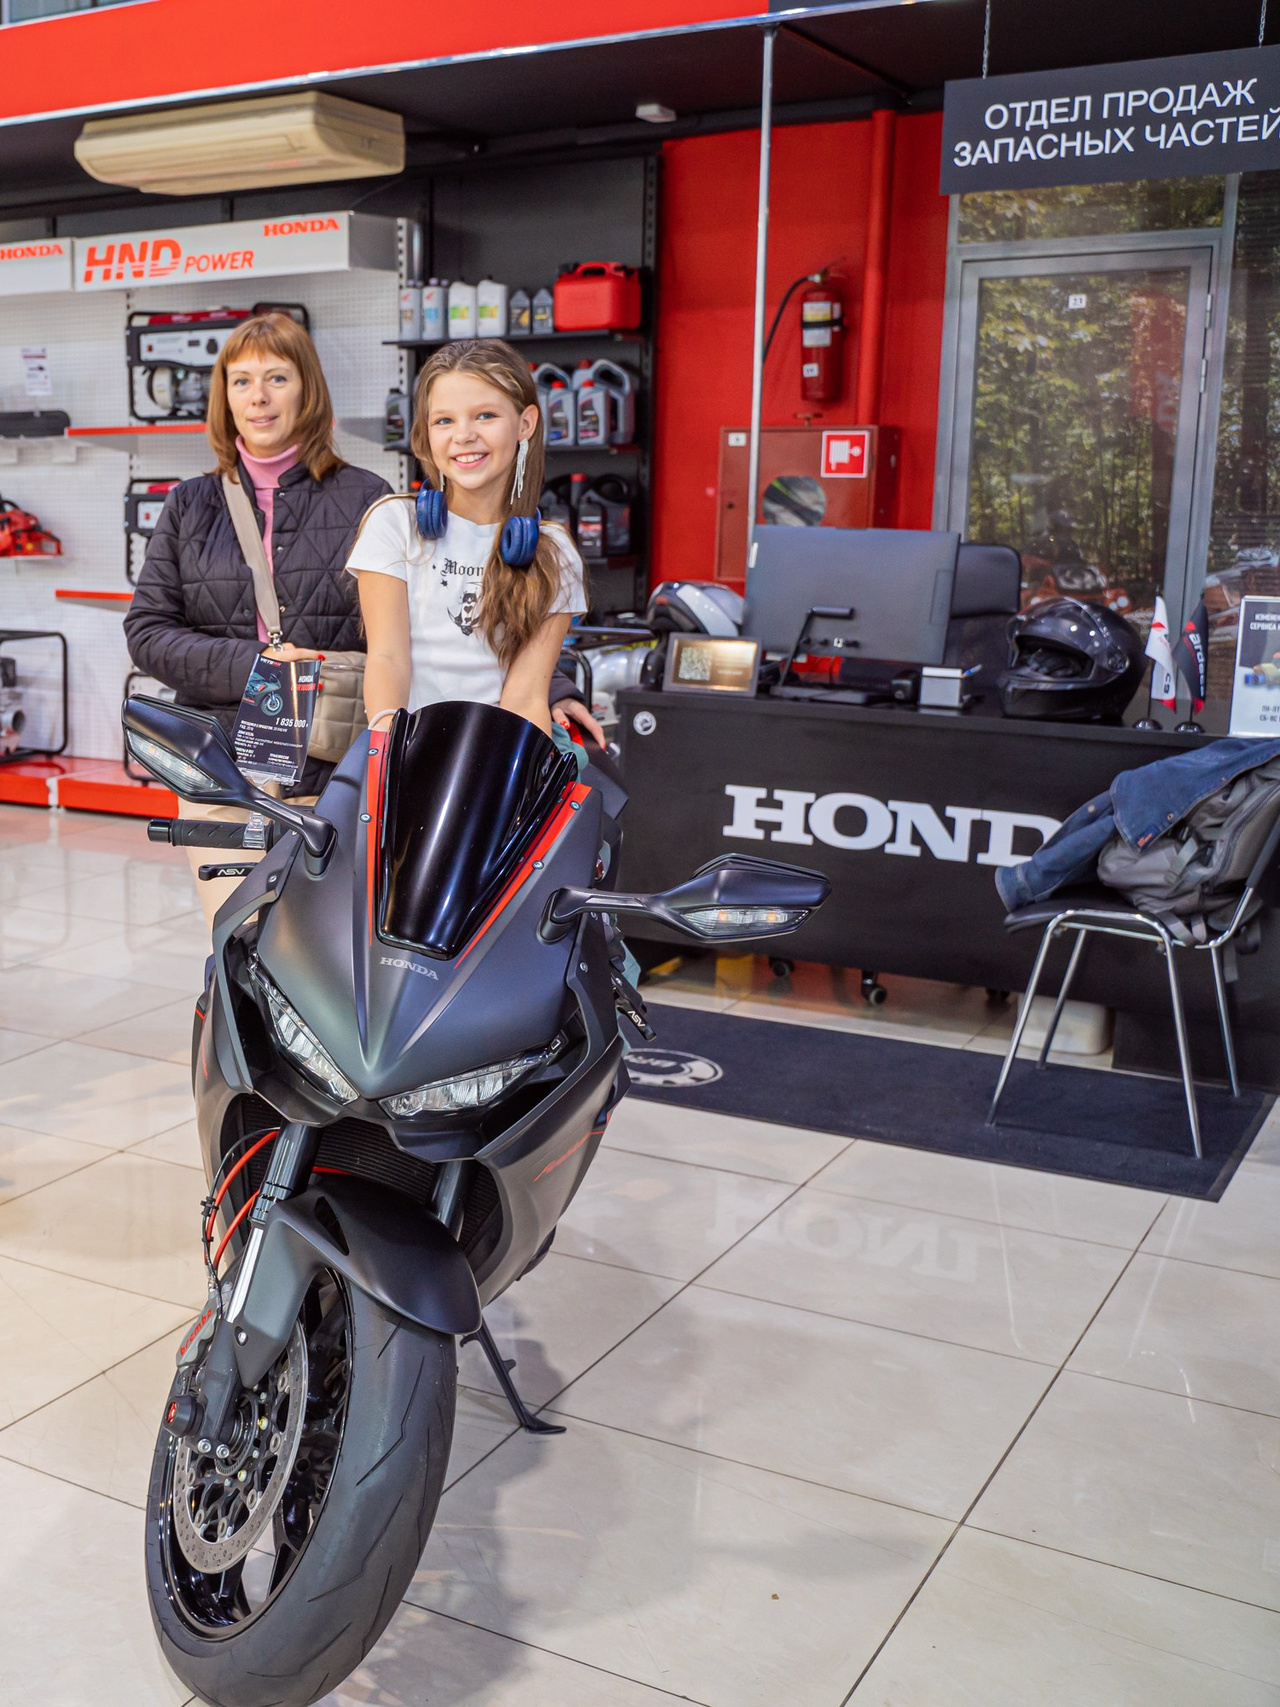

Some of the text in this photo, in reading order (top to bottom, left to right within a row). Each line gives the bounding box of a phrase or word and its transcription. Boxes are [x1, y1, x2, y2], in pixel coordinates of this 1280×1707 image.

[984, 78, 1258, 131] ОТДЕЛ ПРОДАЖ
[953, 126, 1135, 167] ЗАПАСНЫХ
[263, 218, 340, 237] HONDA
[0, 244, 64, 260] HONDA
[84, 238, 254, 283] HND POWER
[280, 718, 293, 727] 835
[722, 784, 1063, 867] HOND
[218, 868, 245, 876] ASV
[380, 957, 439, 980] HONDA
[628, 1010, 646, 1027] ASV
[180, 1308, 212, 1356] brembo
